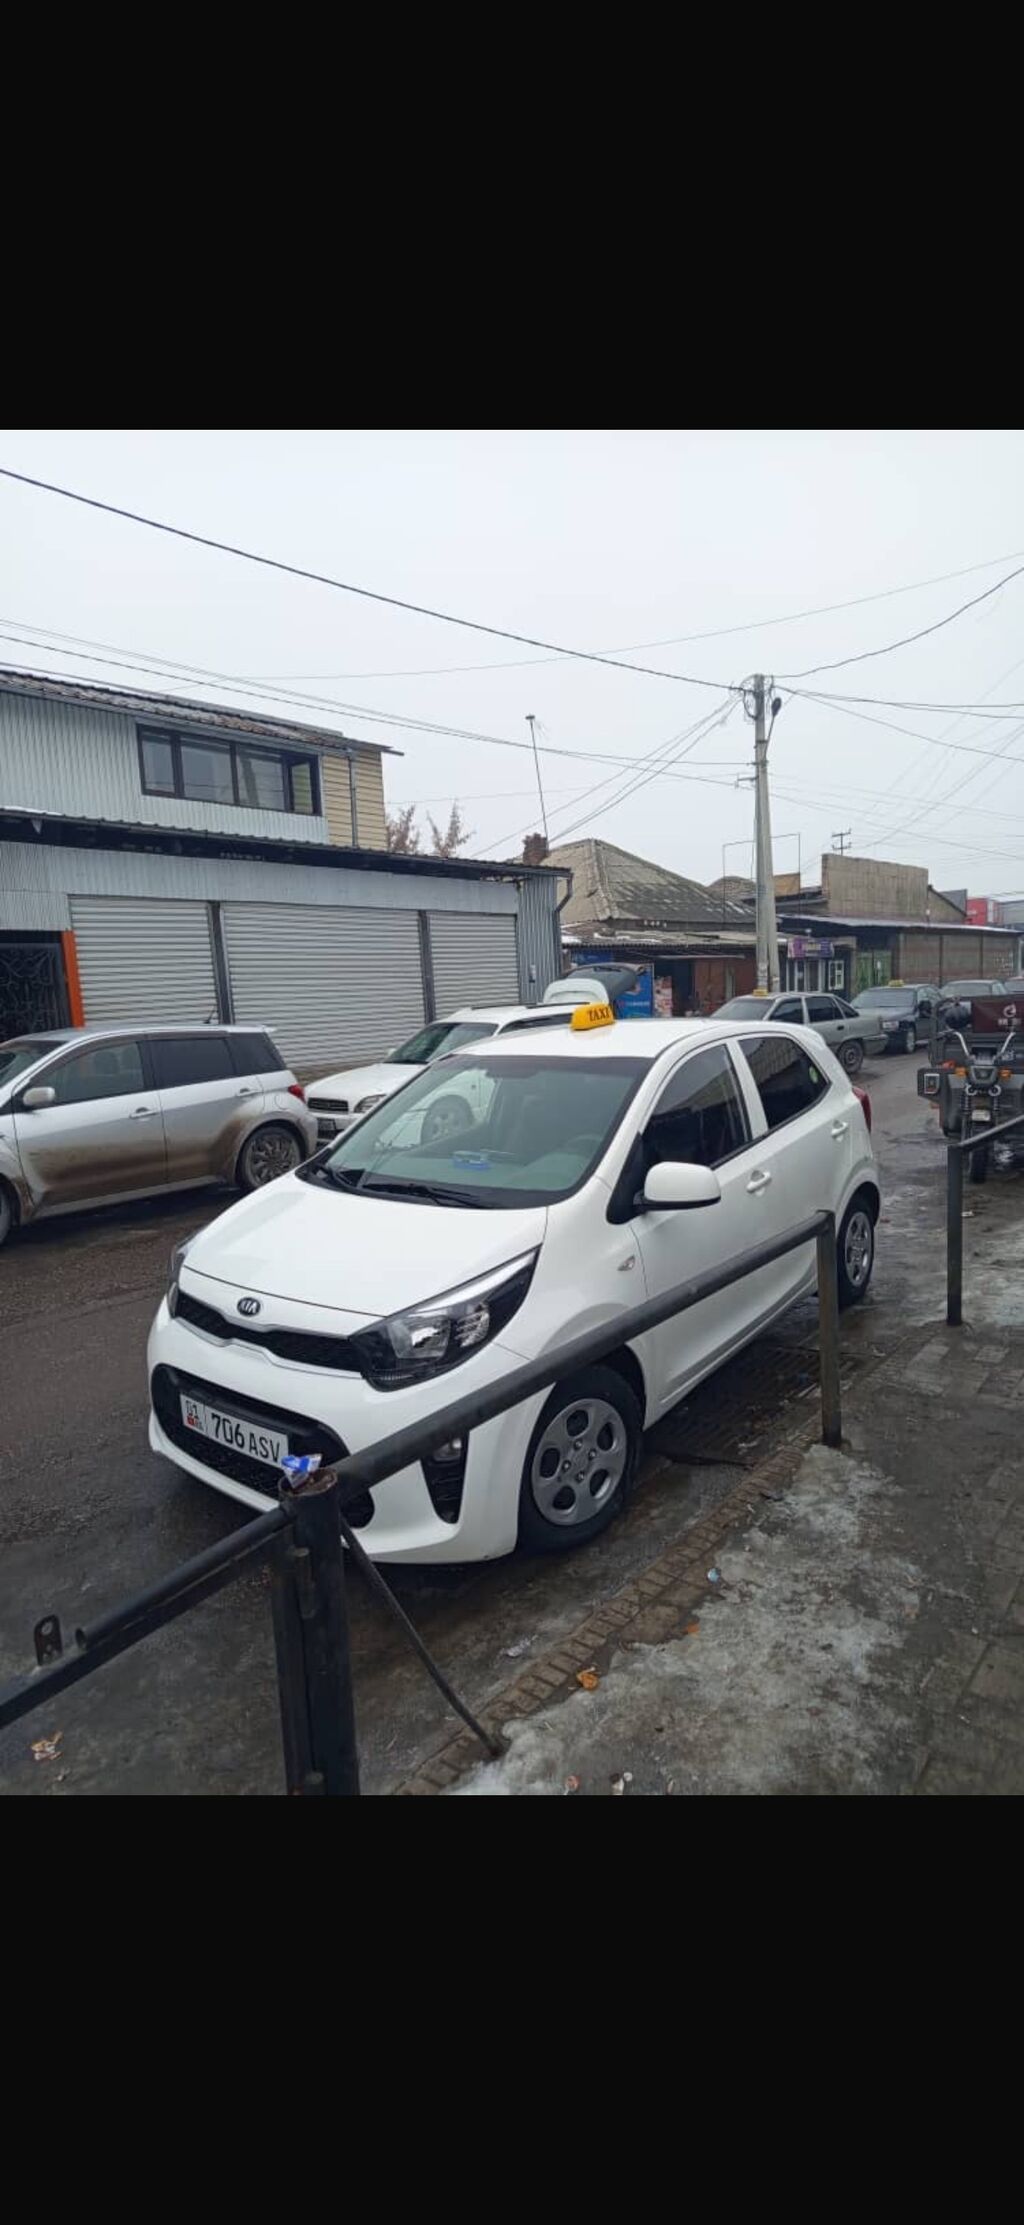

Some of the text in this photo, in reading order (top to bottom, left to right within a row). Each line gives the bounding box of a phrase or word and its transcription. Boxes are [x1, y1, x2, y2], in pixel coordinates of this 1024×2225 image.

[587, 1006, 611, 1022] TAXI
[240, 1300, 257, 1314] KIA
[211, 1412, 281, 1463] 706 ASV
